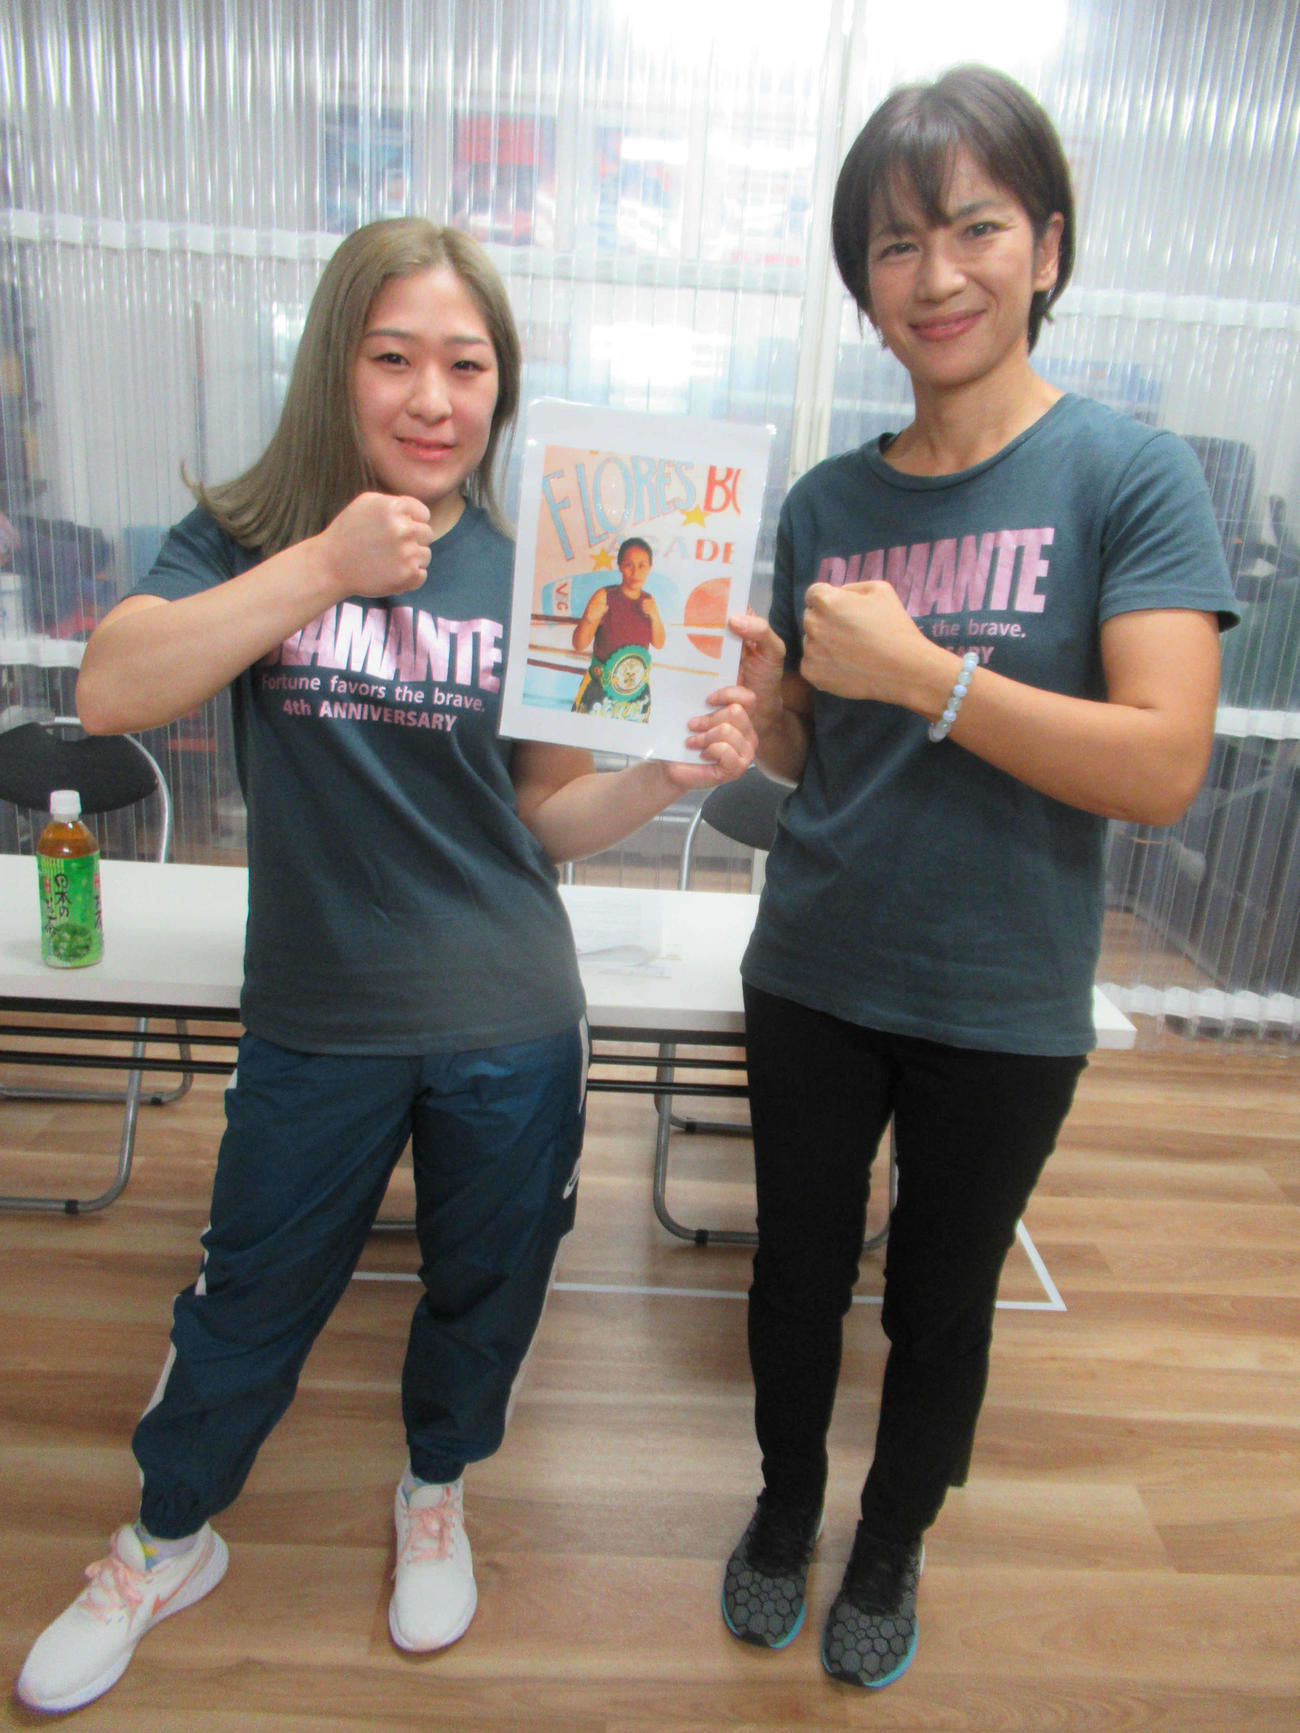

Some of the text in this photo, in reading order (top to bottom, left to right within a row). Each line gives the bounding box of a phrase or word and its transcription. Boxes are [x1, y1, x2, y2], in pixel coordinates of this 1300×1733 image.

[541, 455, 742, 563] FLORES B
[931, 619, 960, 638] the
[967, 619, 1027, 639] brave.
[262, 674, 486, 713] Fortune favors the brave.
[282, 698, 458, 732] 4th ANNIVERSARY
